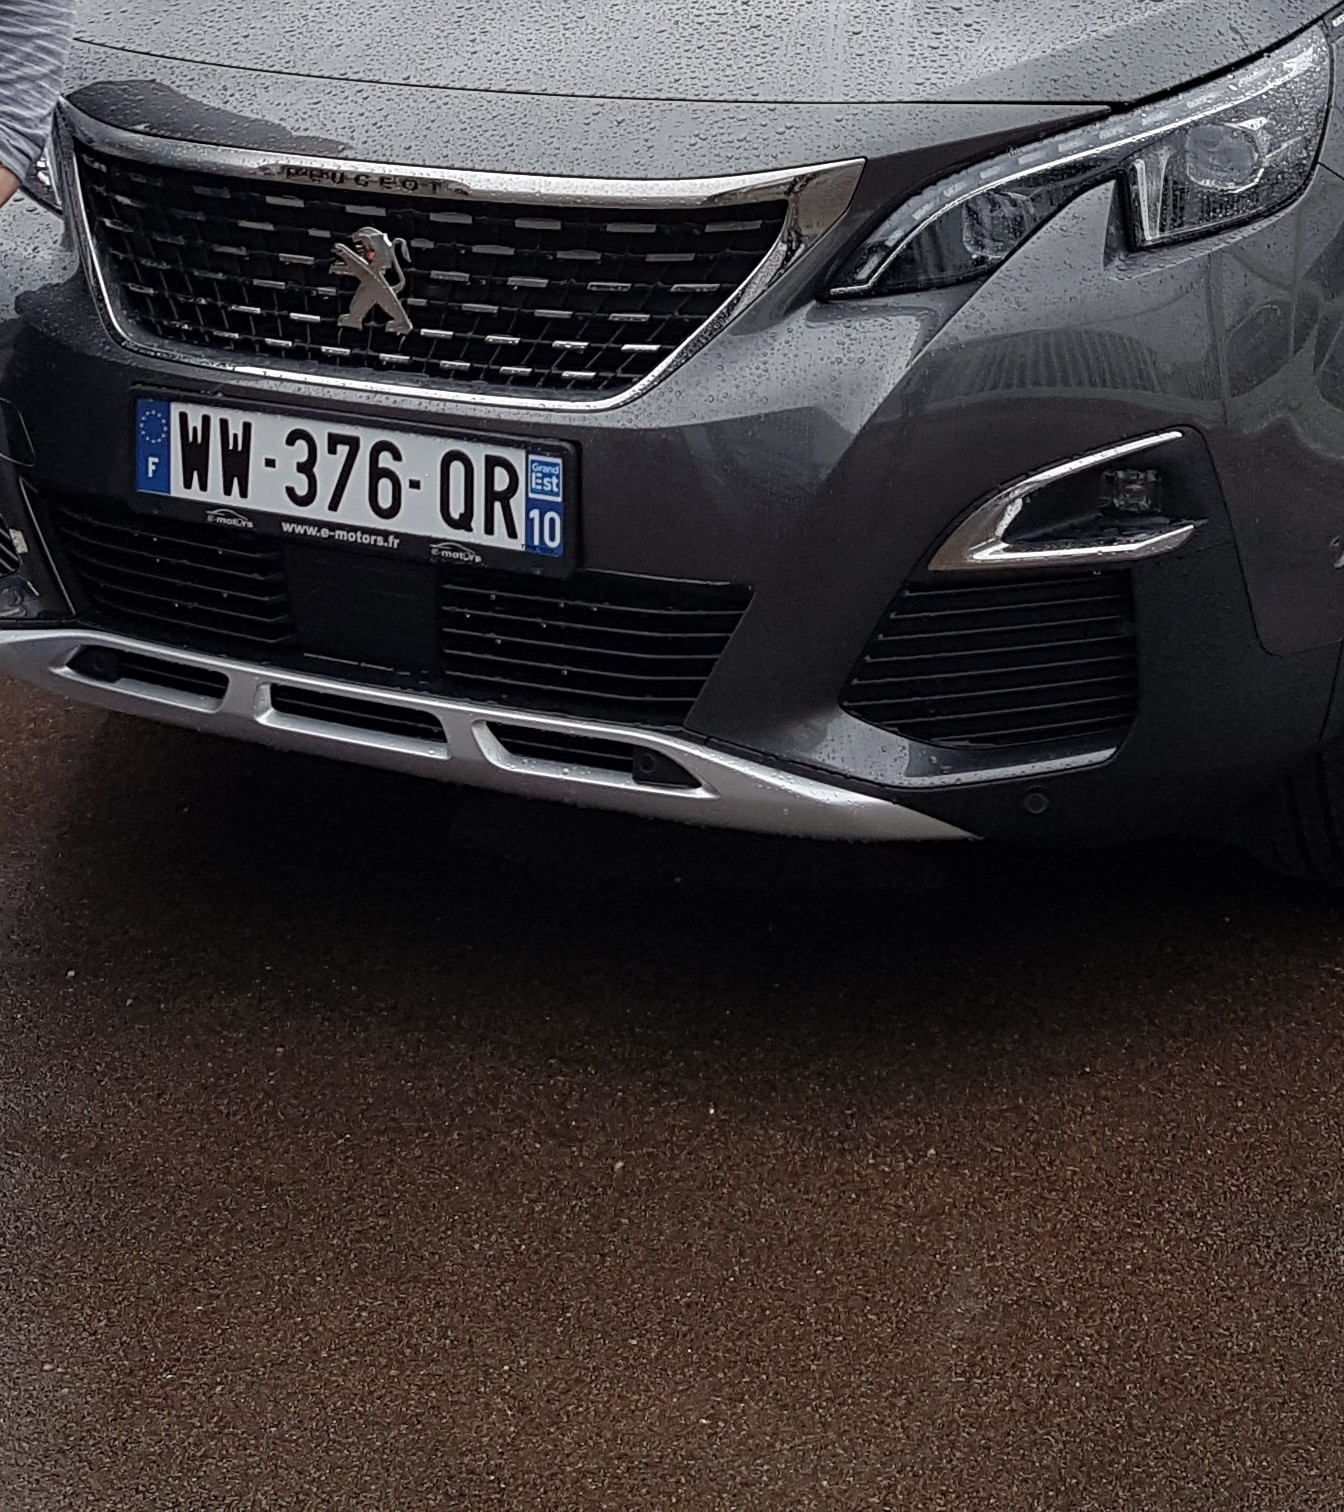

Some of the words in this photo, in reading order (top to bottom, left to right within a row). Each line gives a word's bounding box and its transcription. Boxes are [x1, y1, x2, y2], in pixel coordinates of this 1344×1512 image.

[286, 166, 442, 194] PEUGEOT
[148, 456, 159, 478] F
[179, 411, 520, 540] WW-376-QR
[531, 462, 560, 475] Grand
[531, 472, 559, 492] Est
[281, 521, 400, 549] www.e-motors.fr
[529, 508, 561, 548] 10
